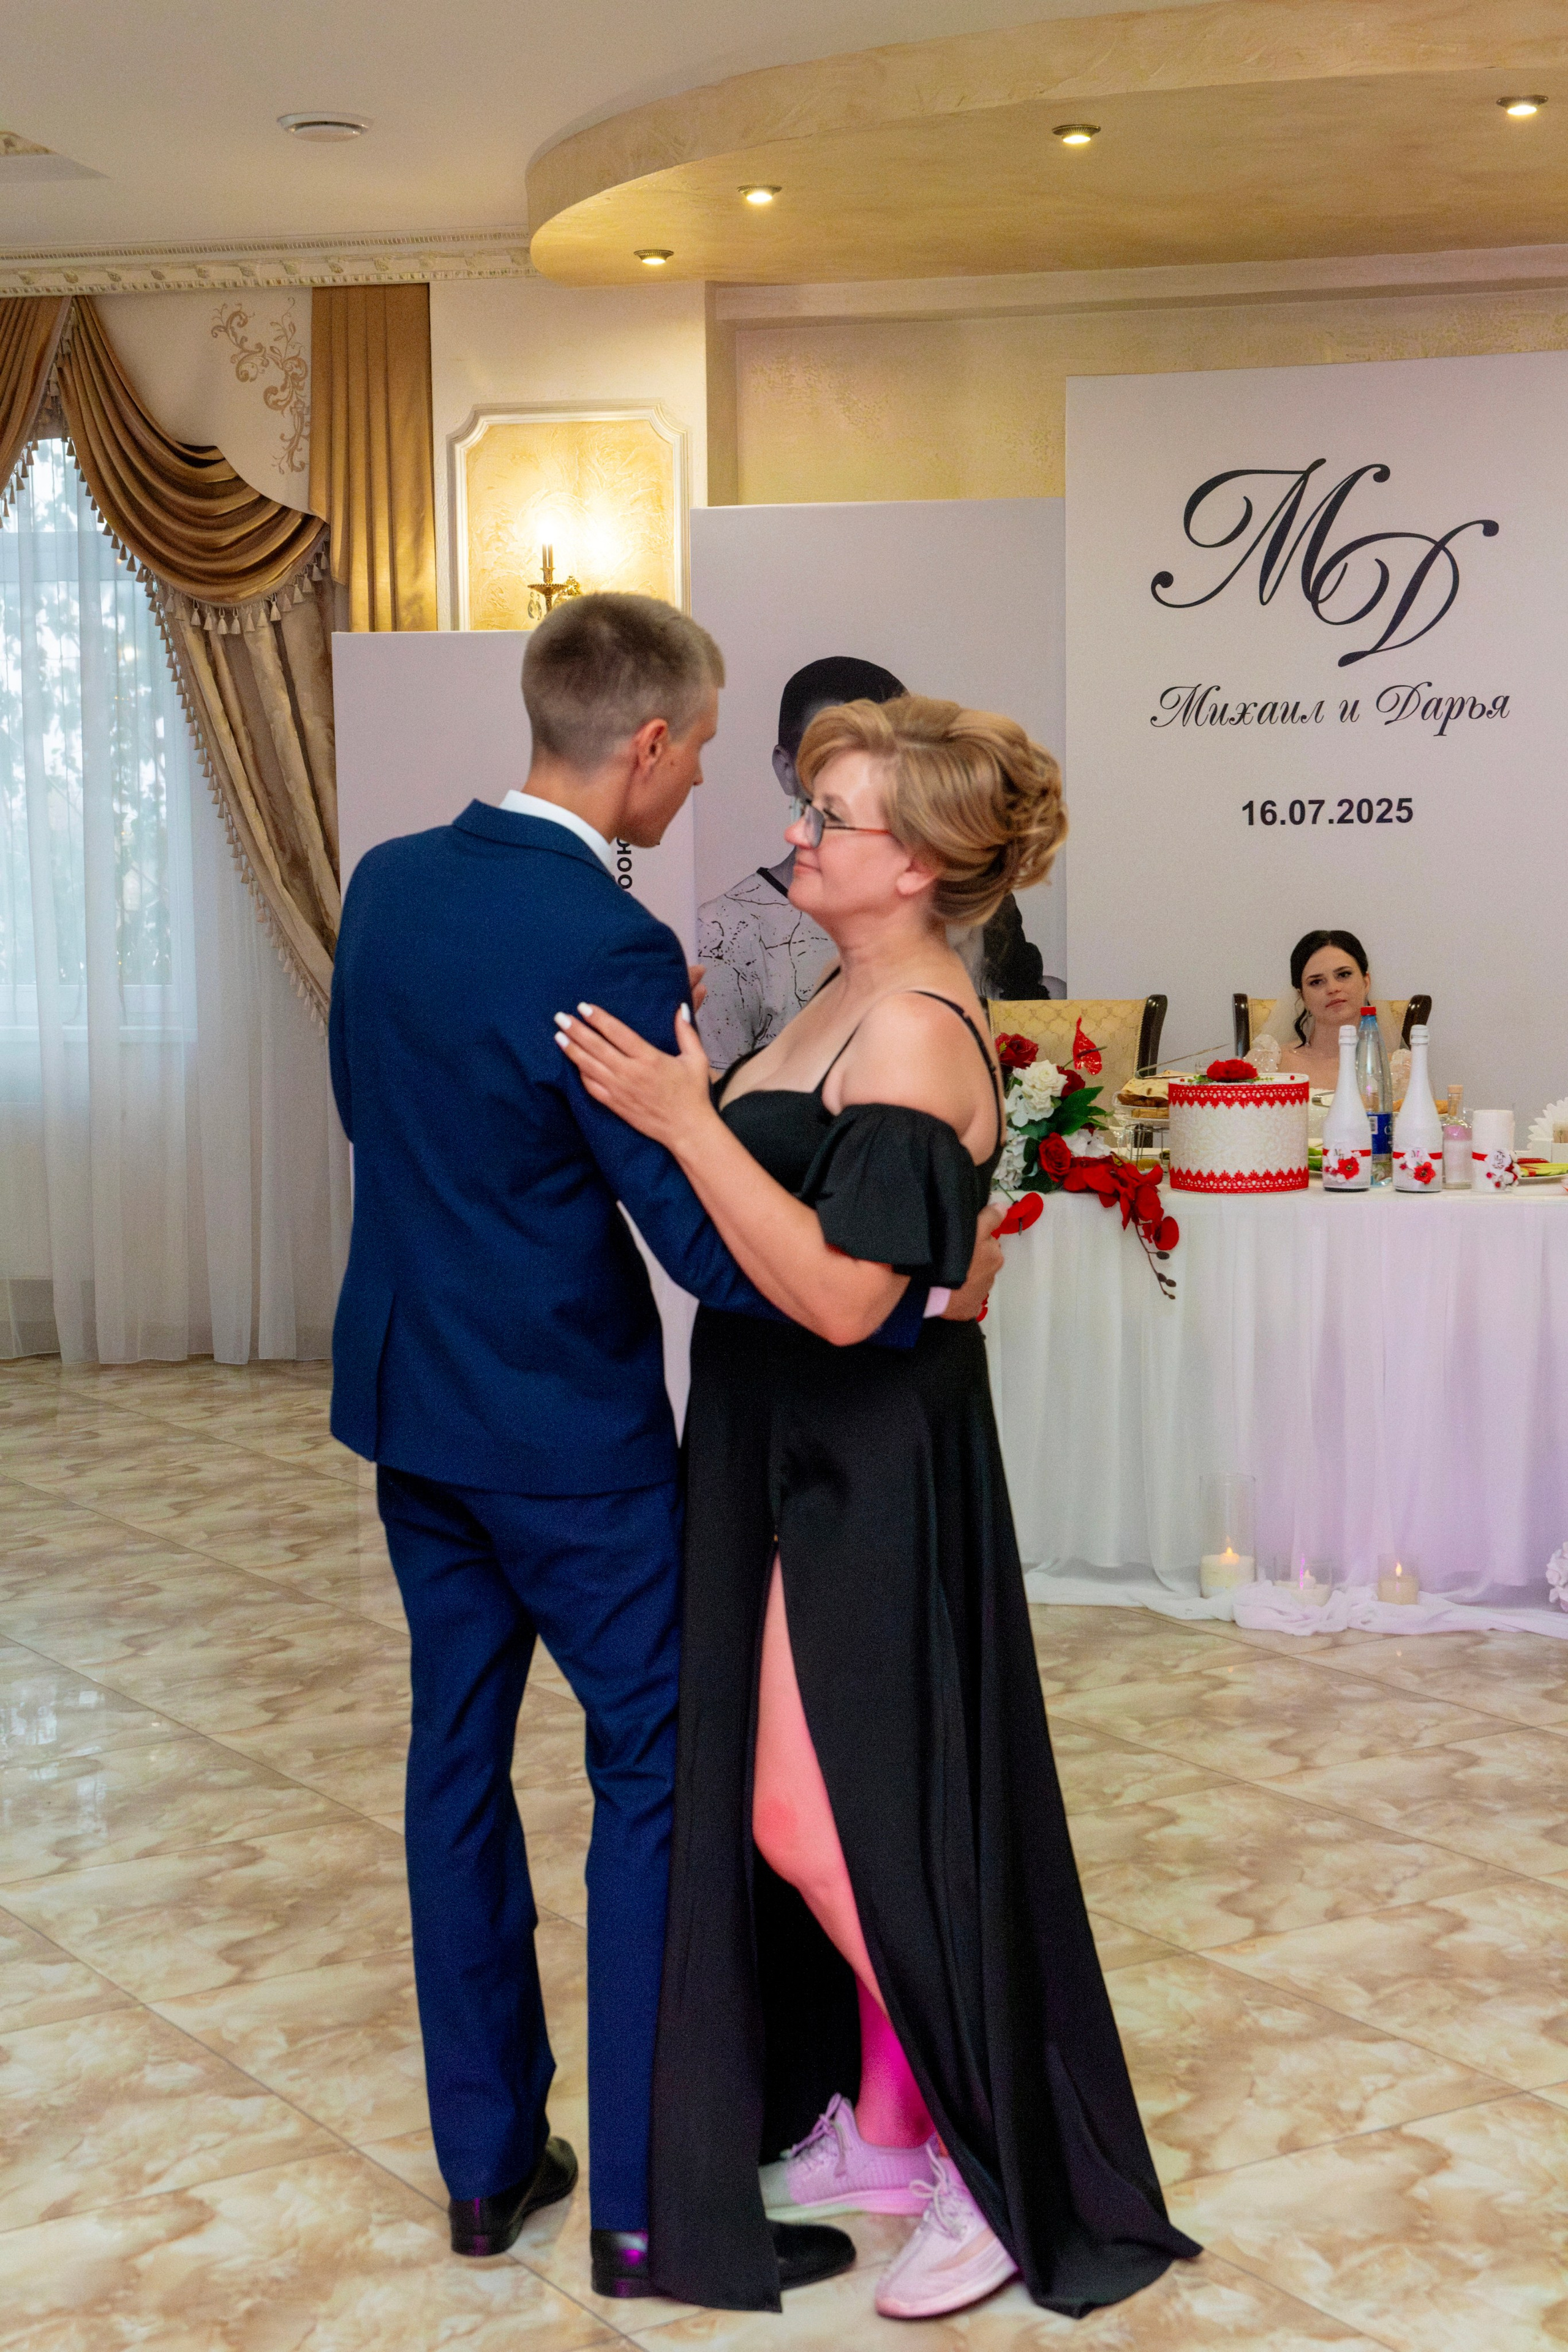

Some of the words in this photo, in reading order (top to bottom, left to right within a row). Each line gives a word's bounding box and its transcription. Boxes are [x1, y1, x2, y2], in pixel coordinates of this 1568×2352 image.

[1150, 683, 1325, 728] Михаил
[1339, 699, 1360, 723] и
[1376, 681, 1510, 737] Дарья
[1242, 797, 1414, 826] 16.07.2025
